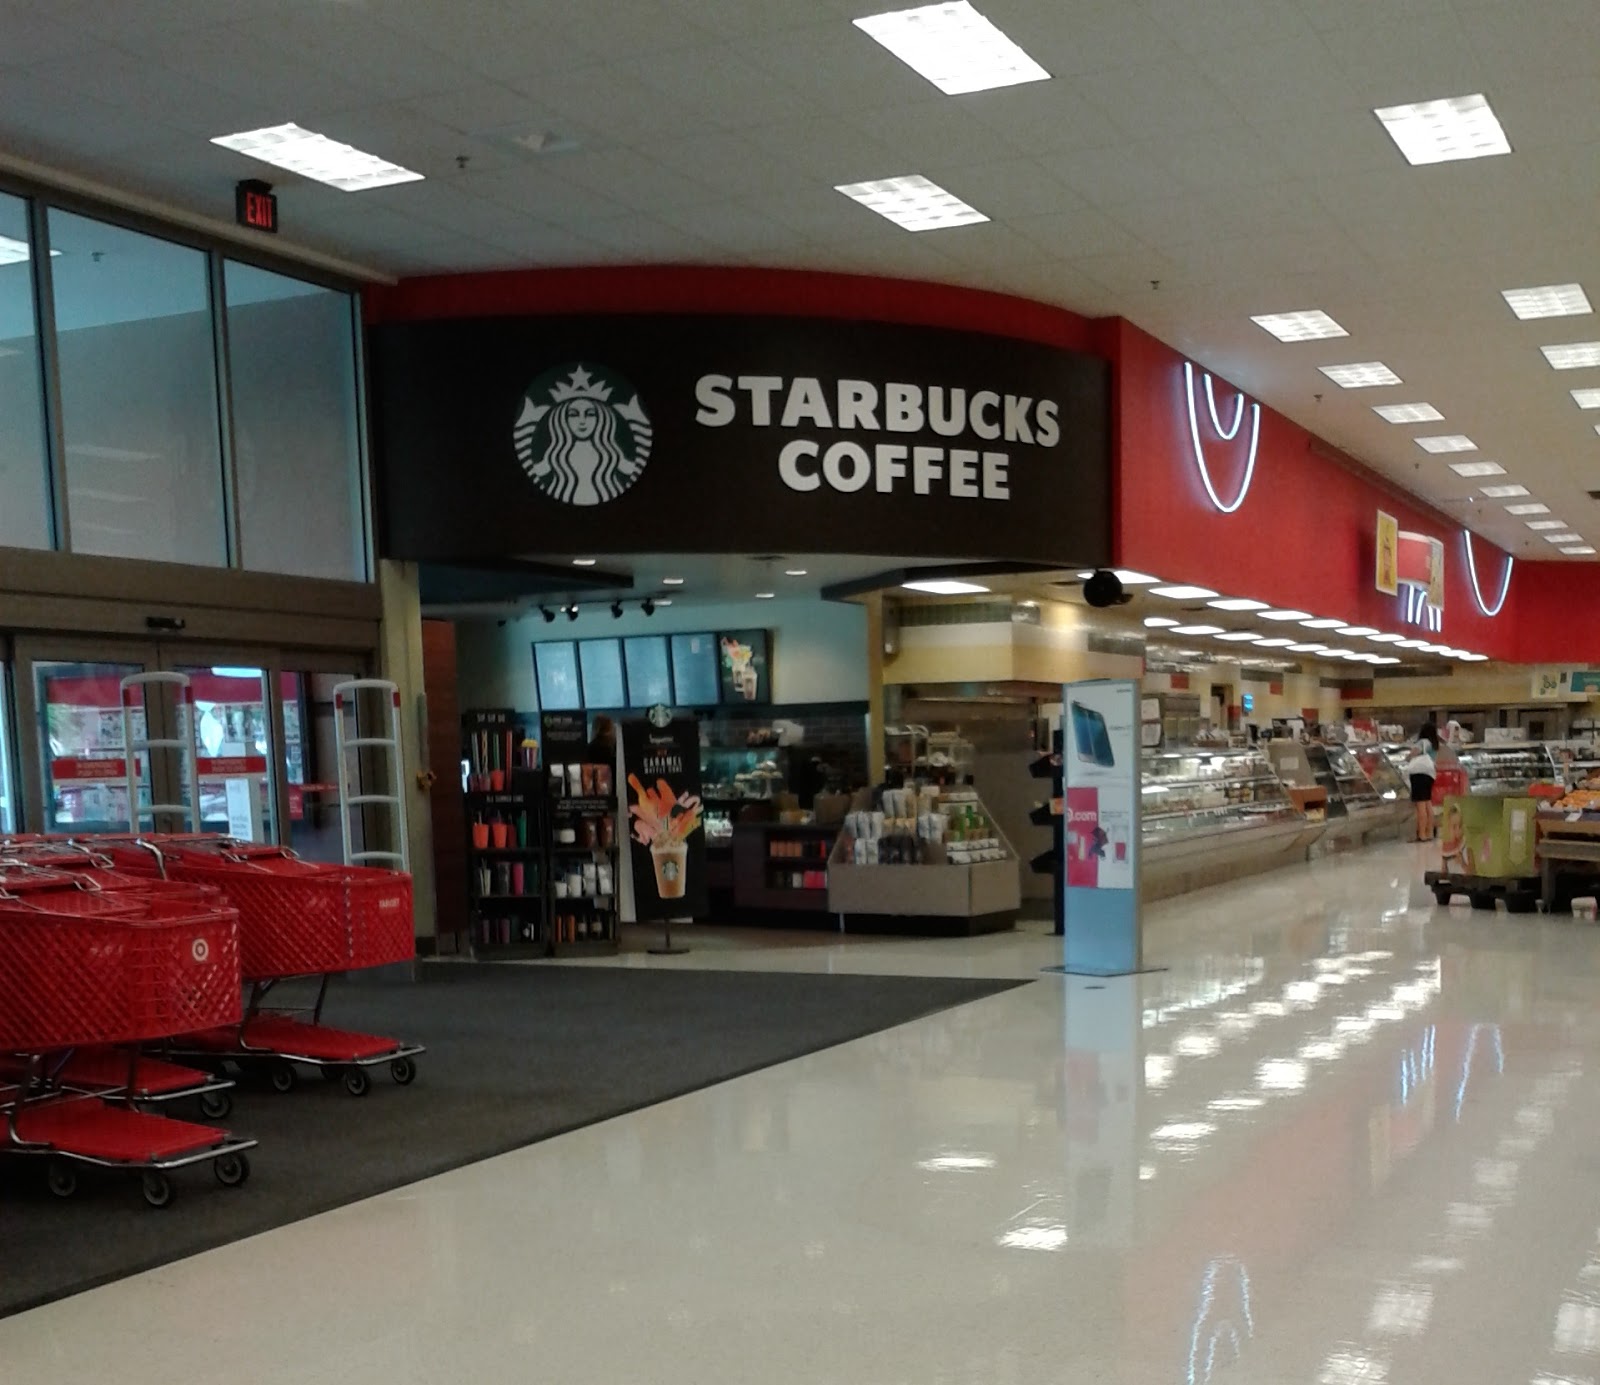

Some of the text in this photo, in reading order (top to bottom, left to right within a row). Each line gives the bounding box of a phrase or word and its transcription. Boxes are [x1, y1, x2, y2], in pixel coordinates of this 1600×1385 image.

[246, 192, 272, 228] EXIT
[694, 374, 1061, 449] STARBUCKS
[778, 440, 1010, 500] COFFEE
[643, 756, 682, 767] CARAMEL
